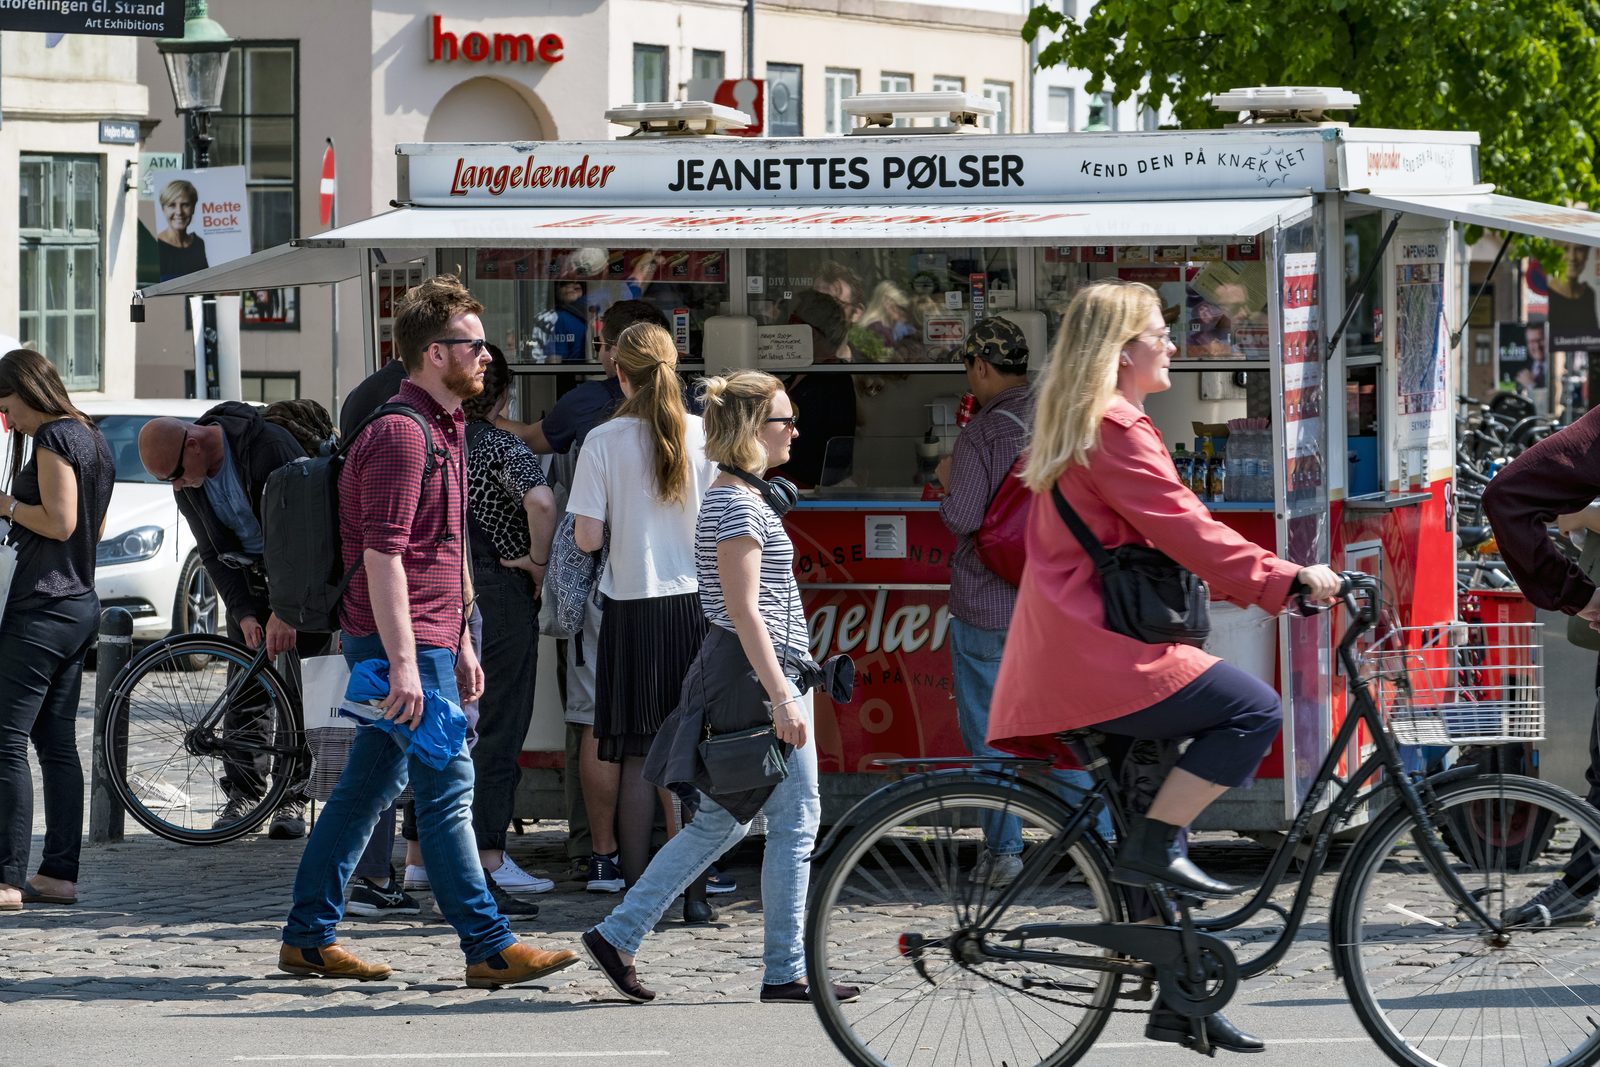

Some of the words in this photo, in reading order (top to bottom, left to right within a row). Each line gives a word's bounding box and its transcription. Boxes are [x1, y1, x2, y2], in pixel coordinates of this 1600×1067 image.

[92, 0, 111, 14] Gl.
[115, 1, 165, 16] Strand
[85, 18, 102, 28] Art
[104, 19, 165, 31] Exhibitions
[430, 14, 564, 64] home
[150, 157, 177, 169] ATM
[1080, 159, 1128, 178] KEND
[1137, 153, 1175, 174] DEN
[1185, 147, 1206, 165] PÅ
[451, 154, 615, 197] Langelænder
[668, 157, 870, 191] JEANETTES
[883, 153, 1025, 191] PØLSER
[201, 201, 241, 214] Mette
[203, 214, 239, 228] Bock
